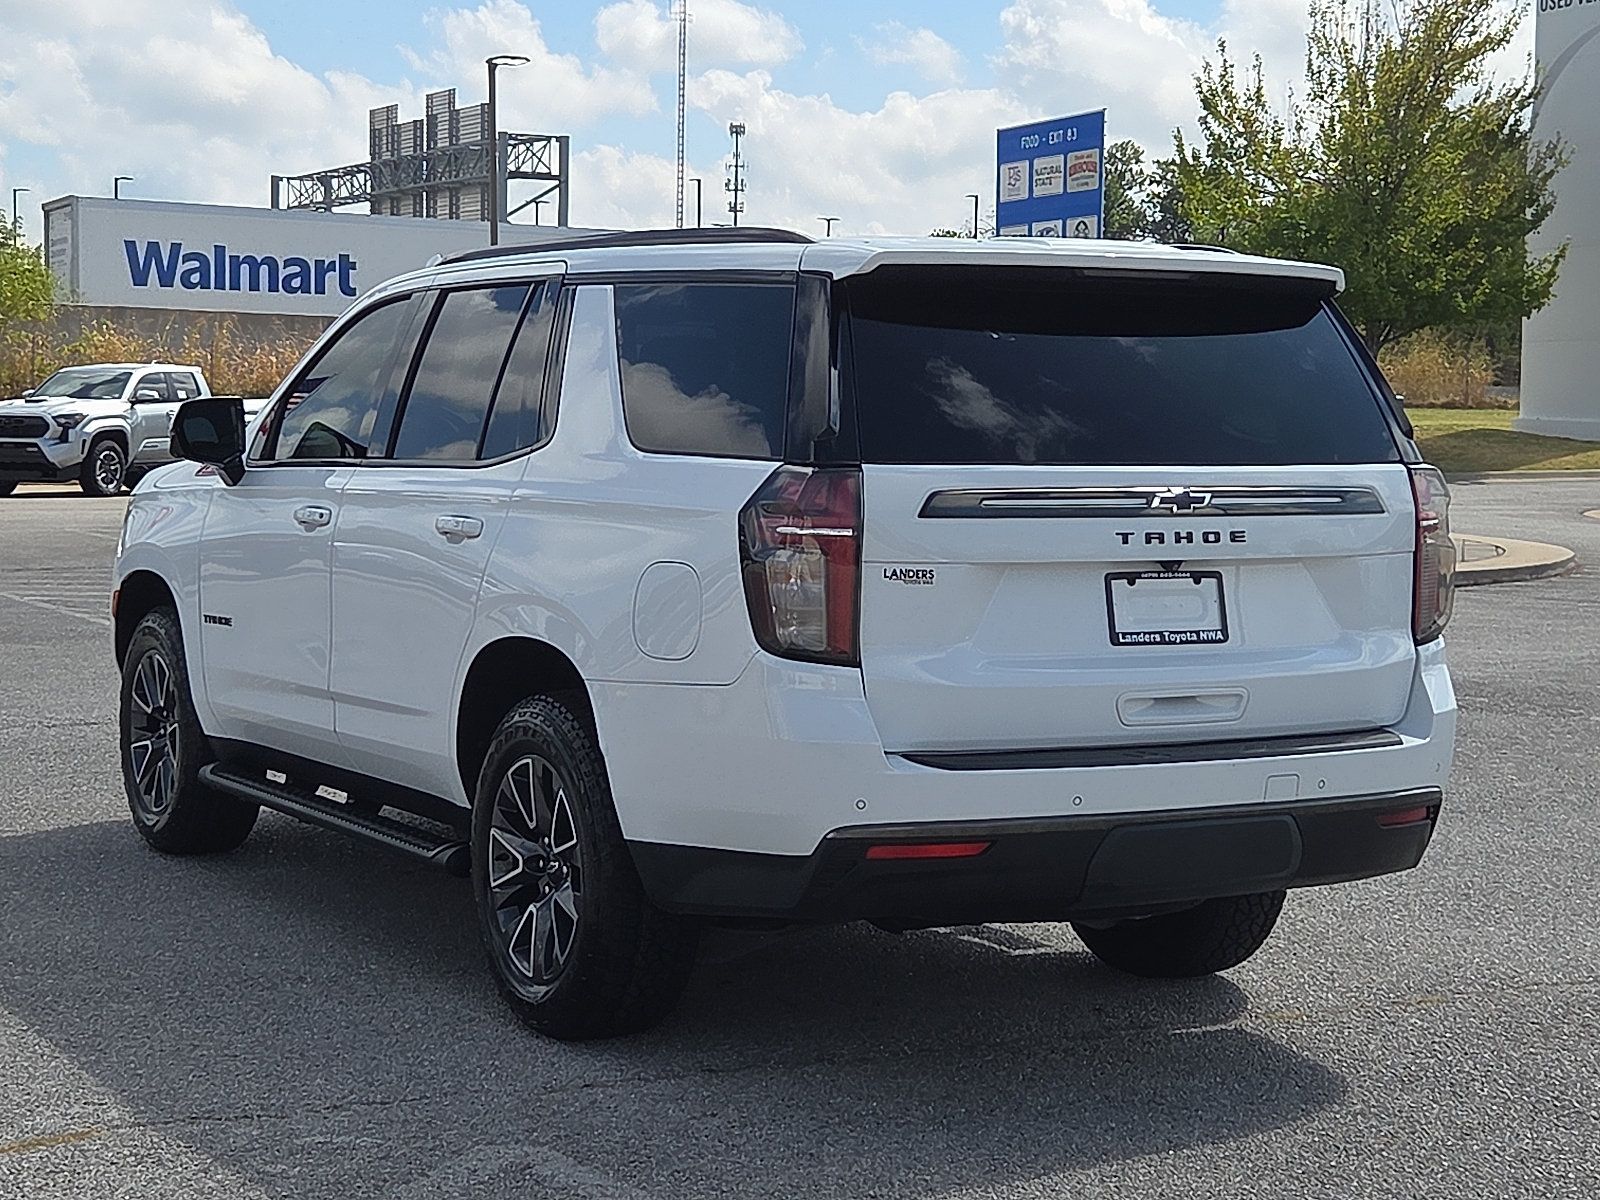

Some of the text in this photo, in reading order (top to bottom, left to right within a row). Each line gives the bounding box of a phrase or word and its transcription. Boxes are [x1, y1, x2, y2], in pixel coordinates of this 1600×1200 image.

[1020, 134, 1040, 149] FOOD
[1048, 130, 1064, 145] EXIT
[123, 239, 357, 297] Walmart
[1114, 530, 1247, 545] TAHOE
[883, 568, 935, 580] LANDERS
[203, 614, 232, 627] TAHOE
[1118, 630, 1224, 643] Landers Toyota NWA
